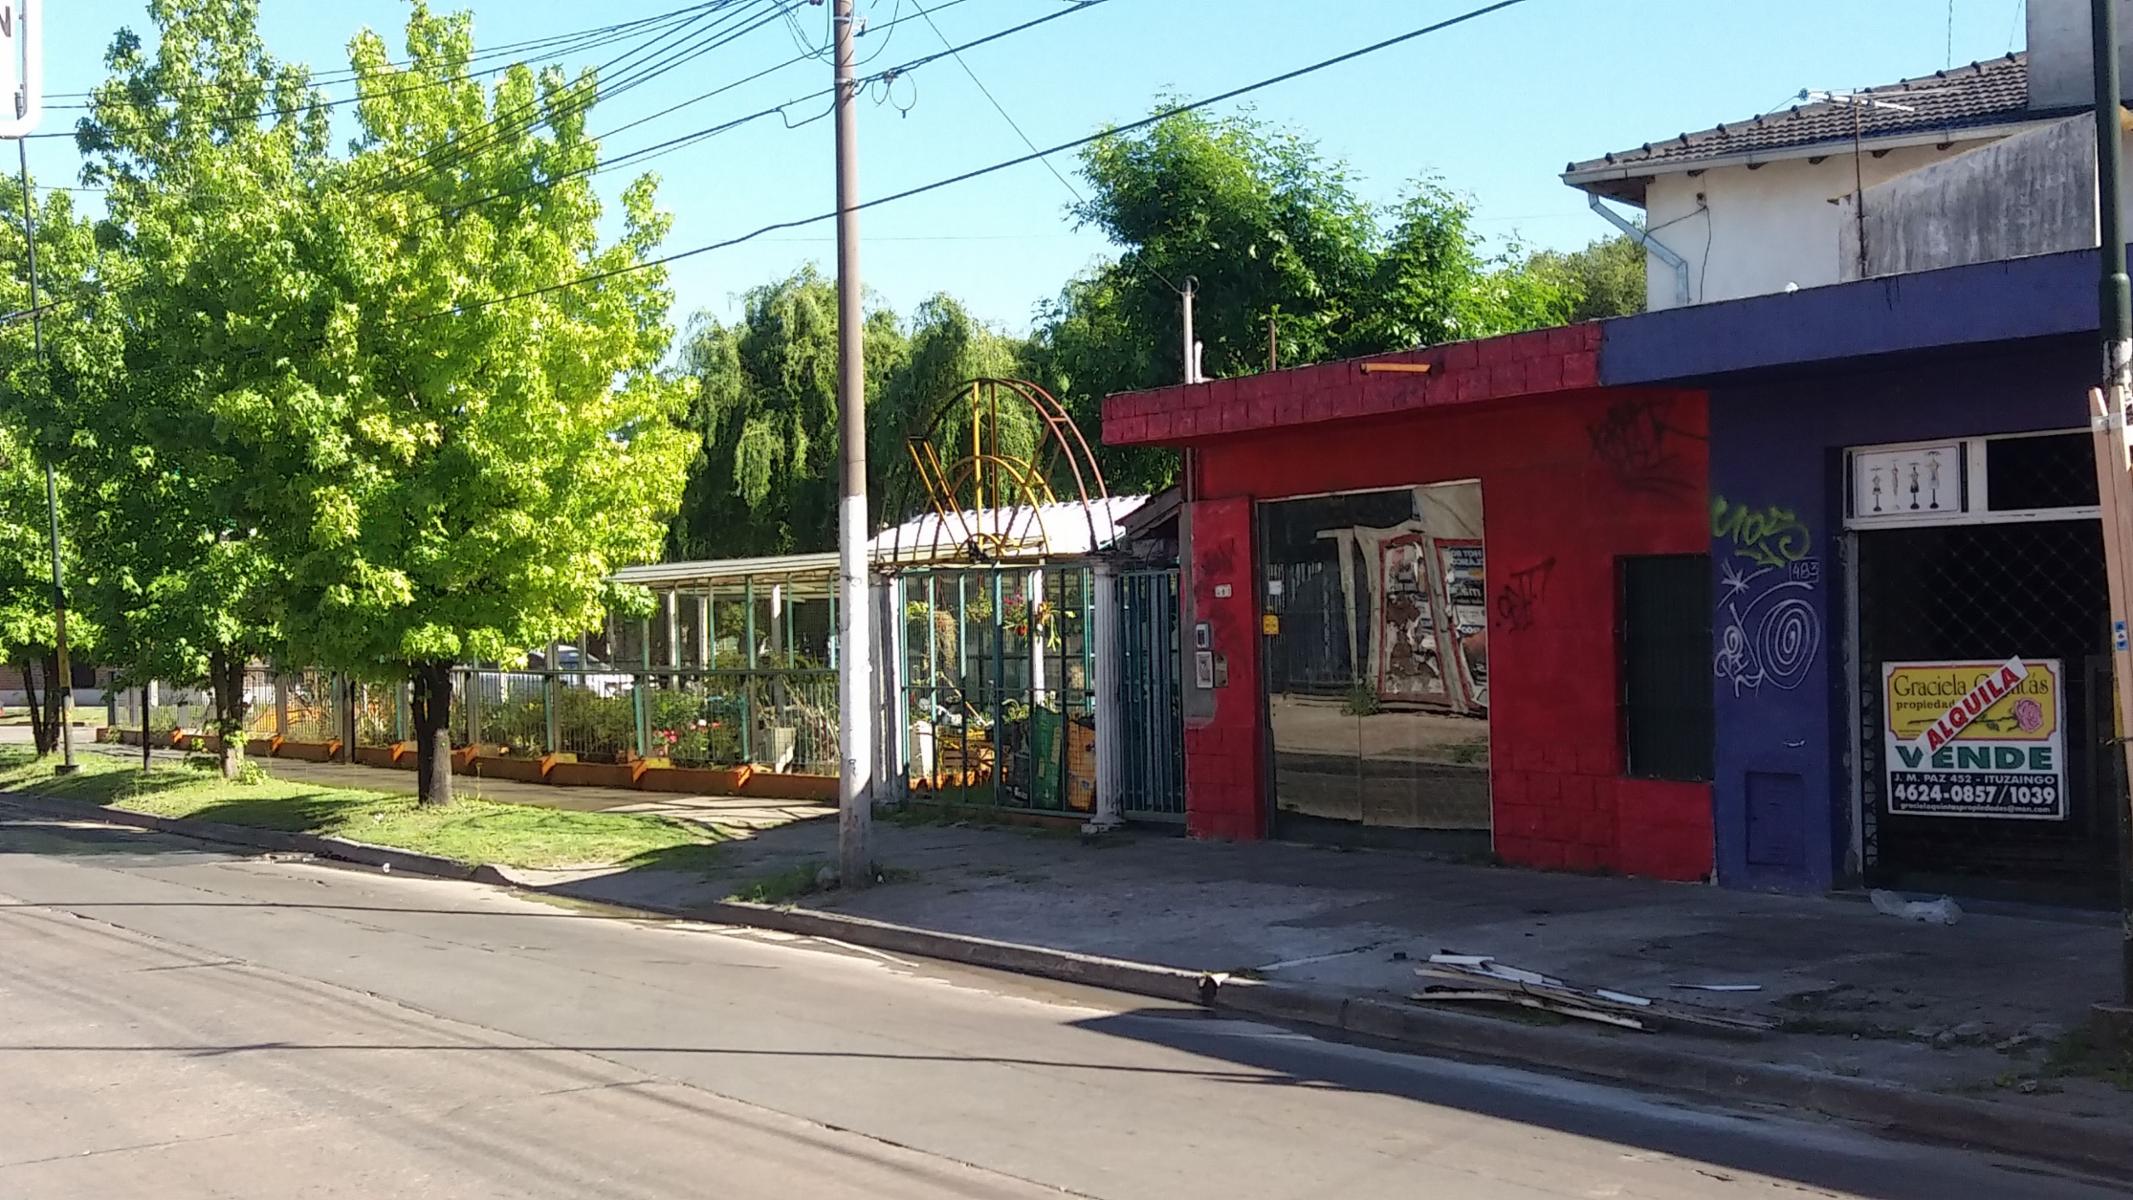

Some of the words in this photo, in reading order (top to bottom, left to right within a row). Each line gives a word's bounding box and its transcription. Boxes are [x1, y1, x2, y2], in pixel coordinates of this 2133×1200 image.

[1894, 674, 1967, 697] Graciela
[1926, 666, 2020, 751] ALQUILA
[1895, 746, 2053, 770] VENDE
[1893, 774, 1902, 782] J.
[1906, 774, 1920, 782] M.
[1924, 774, 1947, 783] PAZ
[1950, 775, 1972, 783] 452
[1984, 775, 2055, 785] ITUZAINGO
[1894, 784, 2056, 804] 4624-0857/1039
